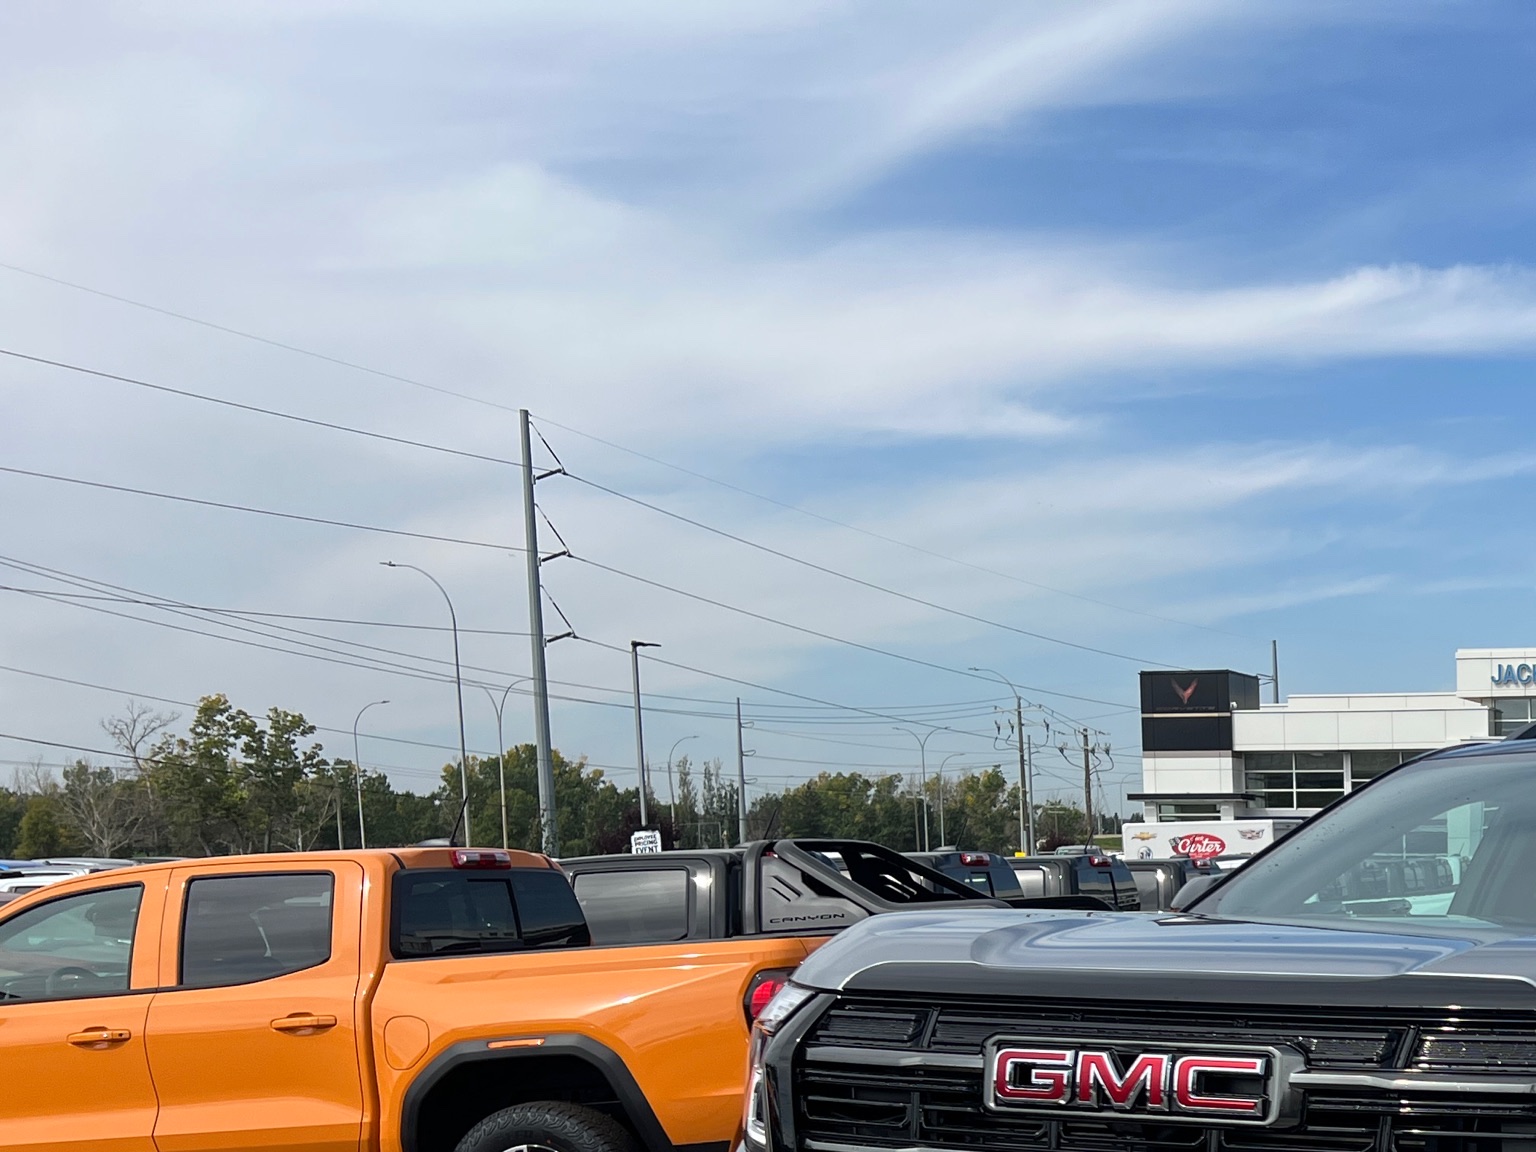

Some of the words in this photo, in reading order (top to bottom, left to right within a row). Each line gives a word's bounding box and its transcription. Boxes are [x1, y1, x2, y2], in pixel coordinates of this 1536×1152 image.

[1177, 837, 1223, 854] Carter
[769, 913, 846, 924] CANYON
[994, 1047, 1269, 1117] GMC
